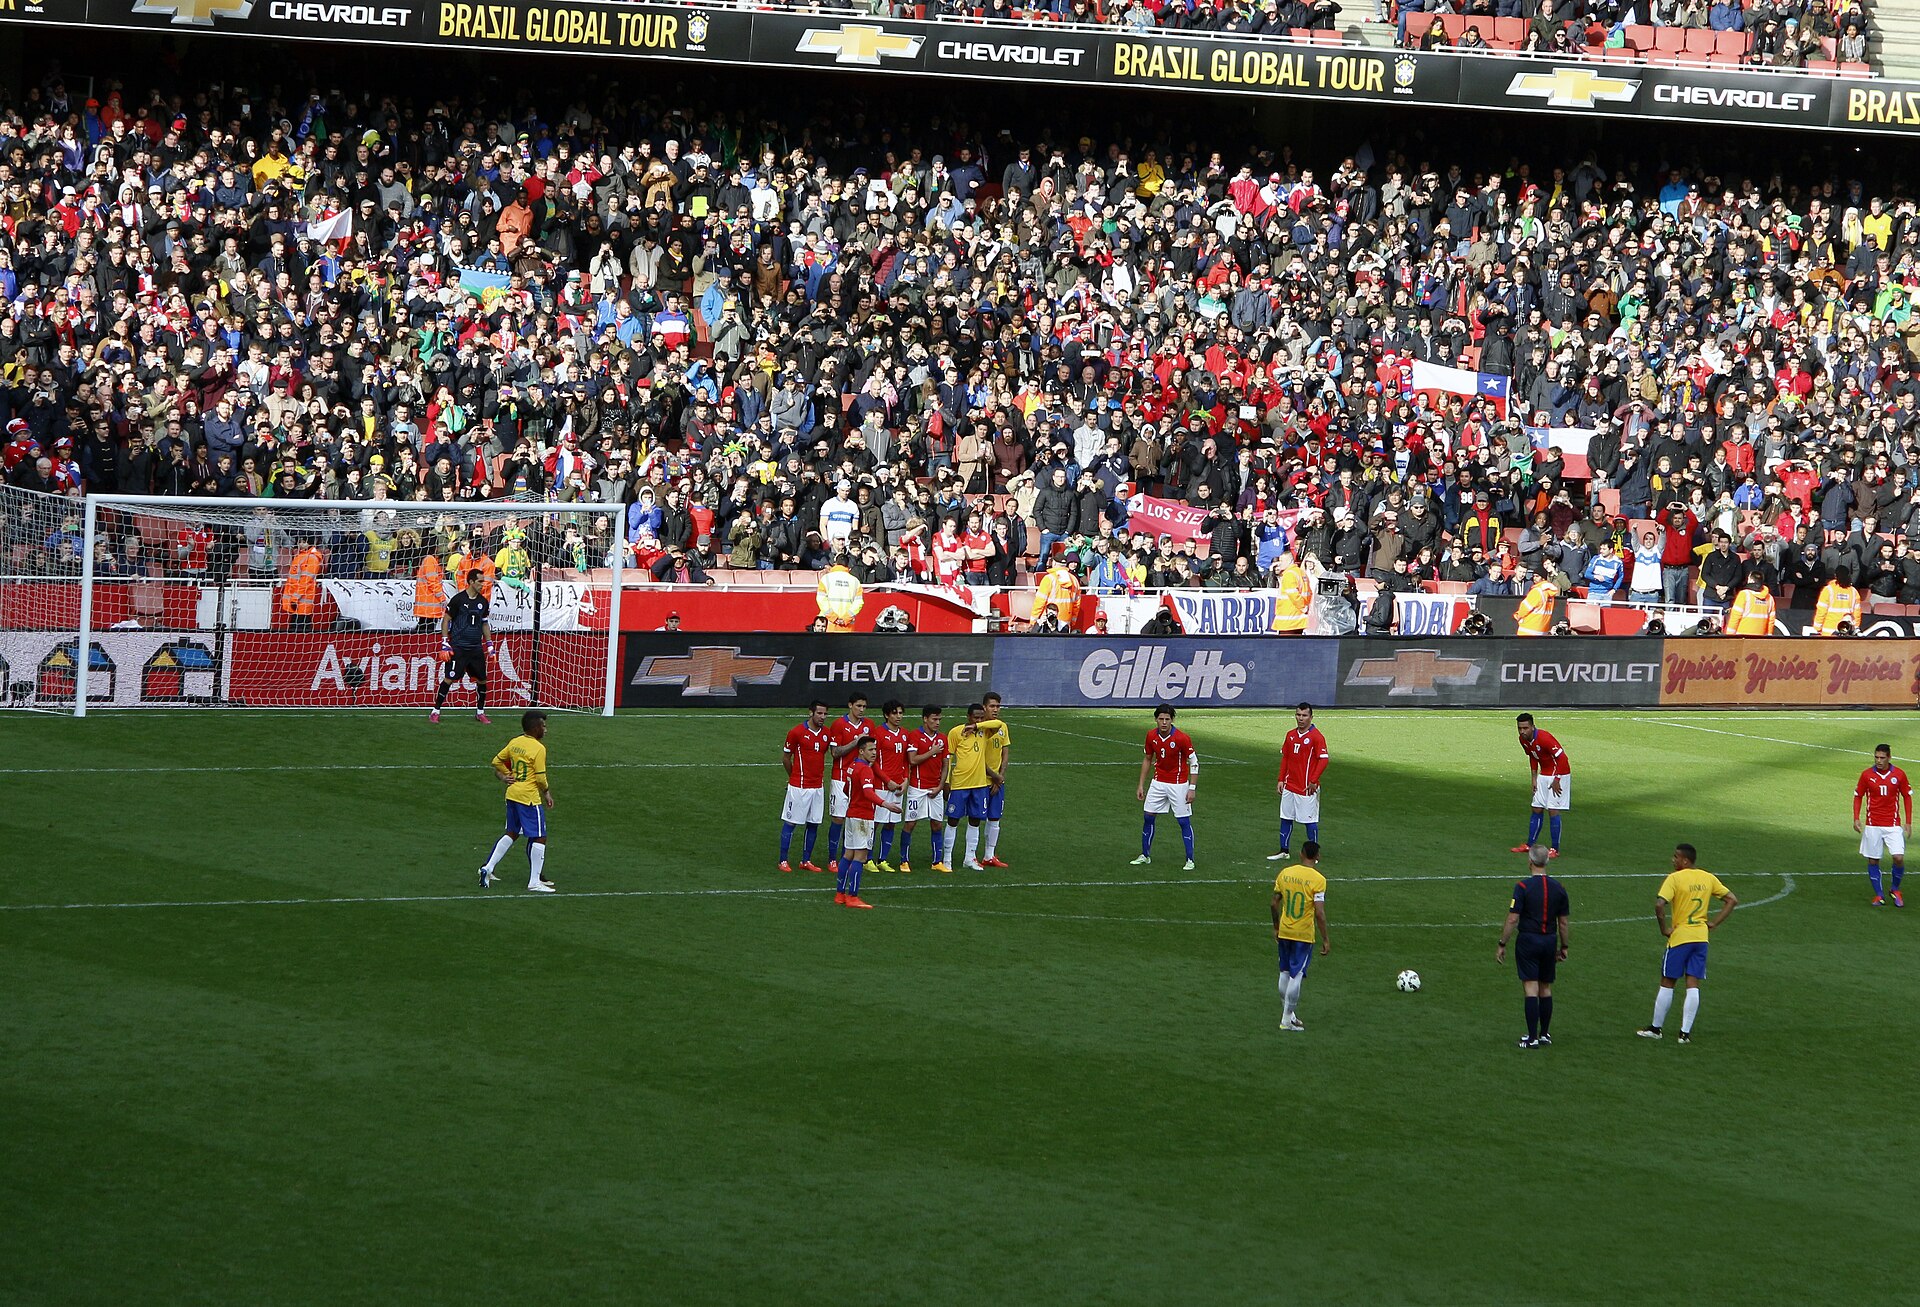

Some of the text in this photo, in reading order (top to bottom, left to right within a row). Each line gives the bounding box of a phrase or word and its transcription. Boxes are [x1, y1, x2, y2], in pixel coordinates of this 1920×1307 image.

[269, 1, 411, 26] CHEVROLET
[526, 7, 611, 45] GLOBAL
[617, 12, 678, 48] TOUR
[938, 41, 1085, 66] CHEVROLET
[1210, 48, 1309, 87] GLOBAL
[1315, 55, 1385, 92] TOUR
[1653, 84, 1816, 111] CHEVROLET
[1147, 503, 1173, 521] LOS
[809, 661, 989, 682] CHEVROLET
[1079, 646, 1246, 700] Gillette
[1501, 663, 1659, 683] CHEVROLET
[895, 743, 902, 753] 14
[973, 741, 979, 752] 8
[1160, 748, 1165, 758] 3
[1879, 785, 1888, 796] 11
[909, 800, 918, 810] 20
[1285, 889, 1305, 919] 10
[1688, 898, 1702, 925] 2
